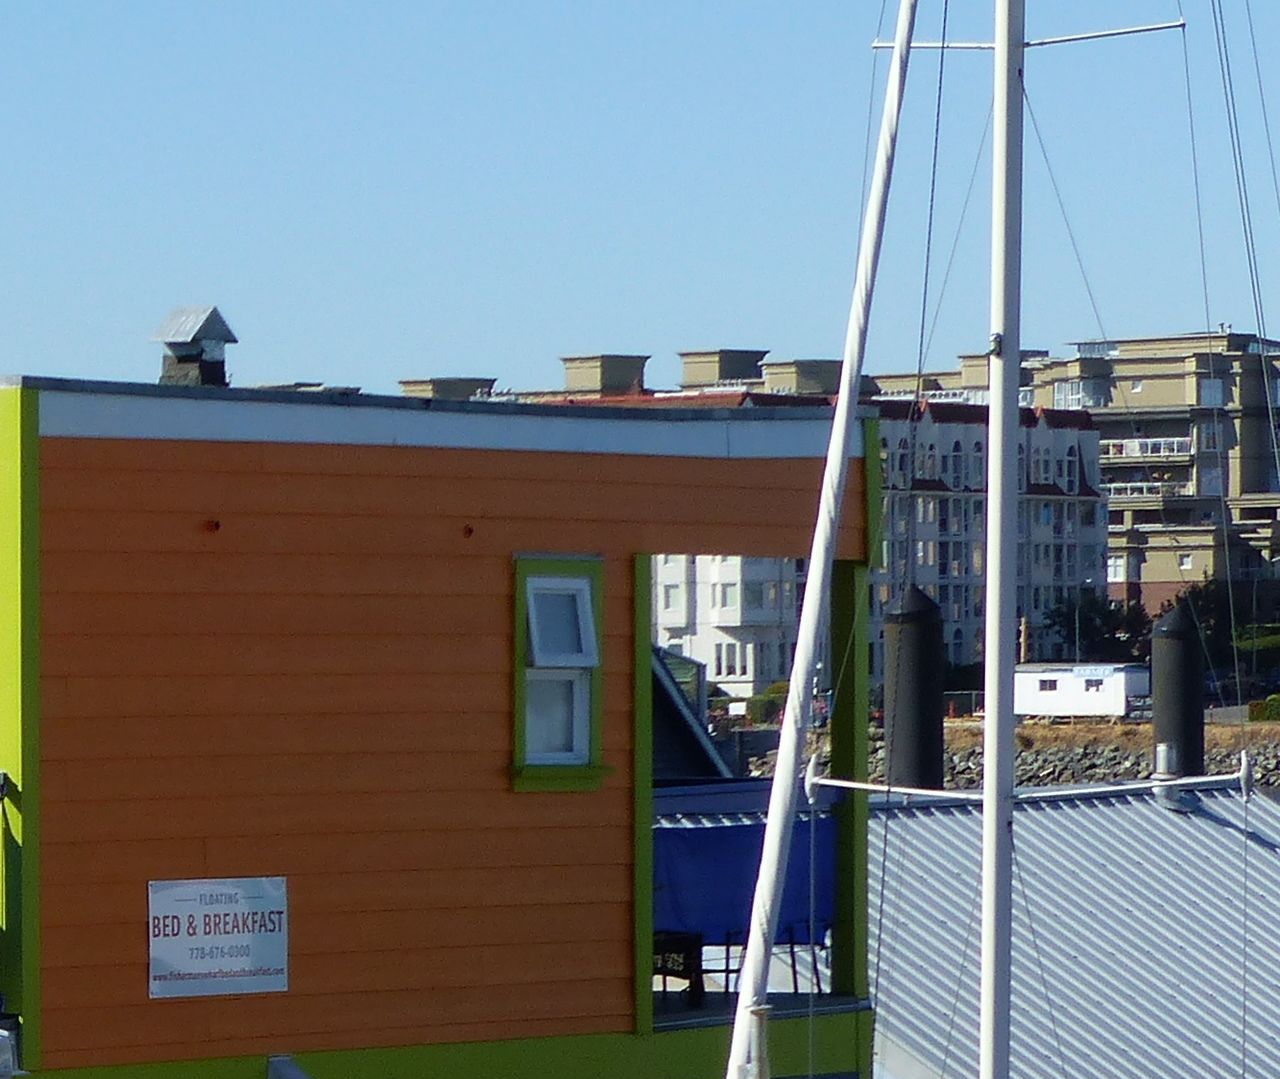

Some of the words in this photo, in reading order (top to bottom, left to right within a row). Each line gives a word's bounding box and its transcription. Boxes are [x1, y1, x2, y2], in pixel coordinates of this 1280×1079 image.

[199, 892, 239, 906] FLOATING
[152, 915, 180, 938] BED
[187, 914, 197, 937] &
[203, 911, 284, 936] BREAKFAST
